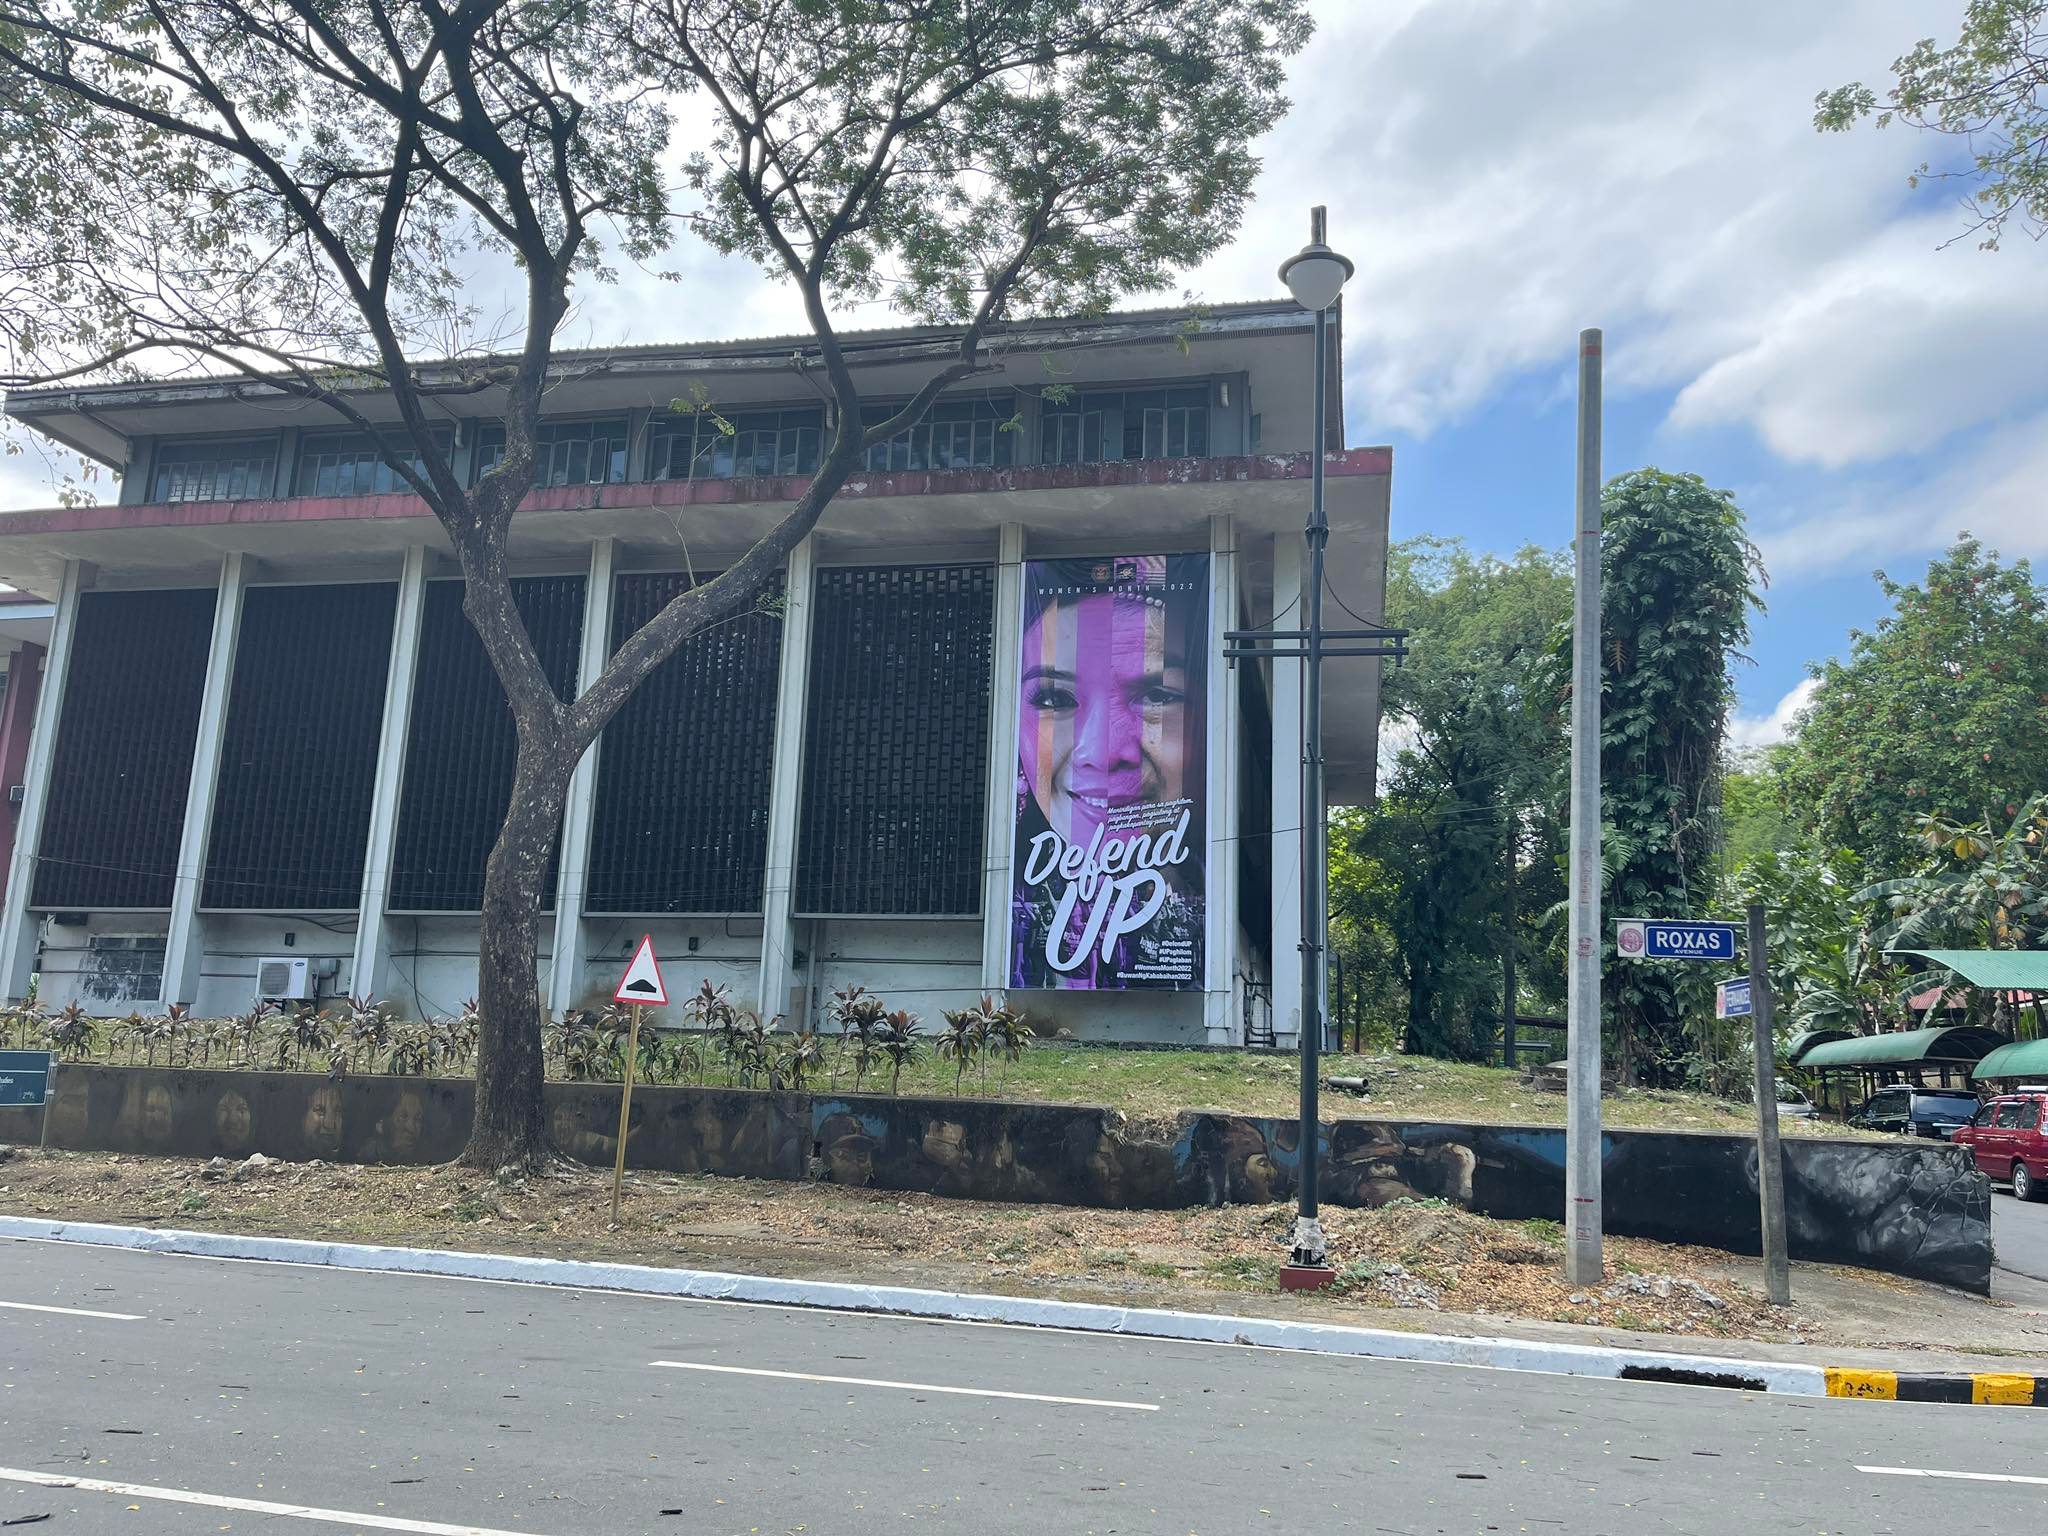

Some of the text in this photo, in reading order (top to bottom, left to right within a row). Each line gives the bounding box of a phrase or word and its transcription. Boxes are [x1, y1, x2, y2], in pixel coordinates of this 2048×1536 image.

[1039, 583, 1193, 595] WOMEN'S MONTH 2022
[1023, 808, 1190, 902] Defend
[1045, 868, 1167, 972] UP
[1656, 931, 1720, 950] ROXAS
[1134, 964, 1192, 972] #WomensMonth2022
